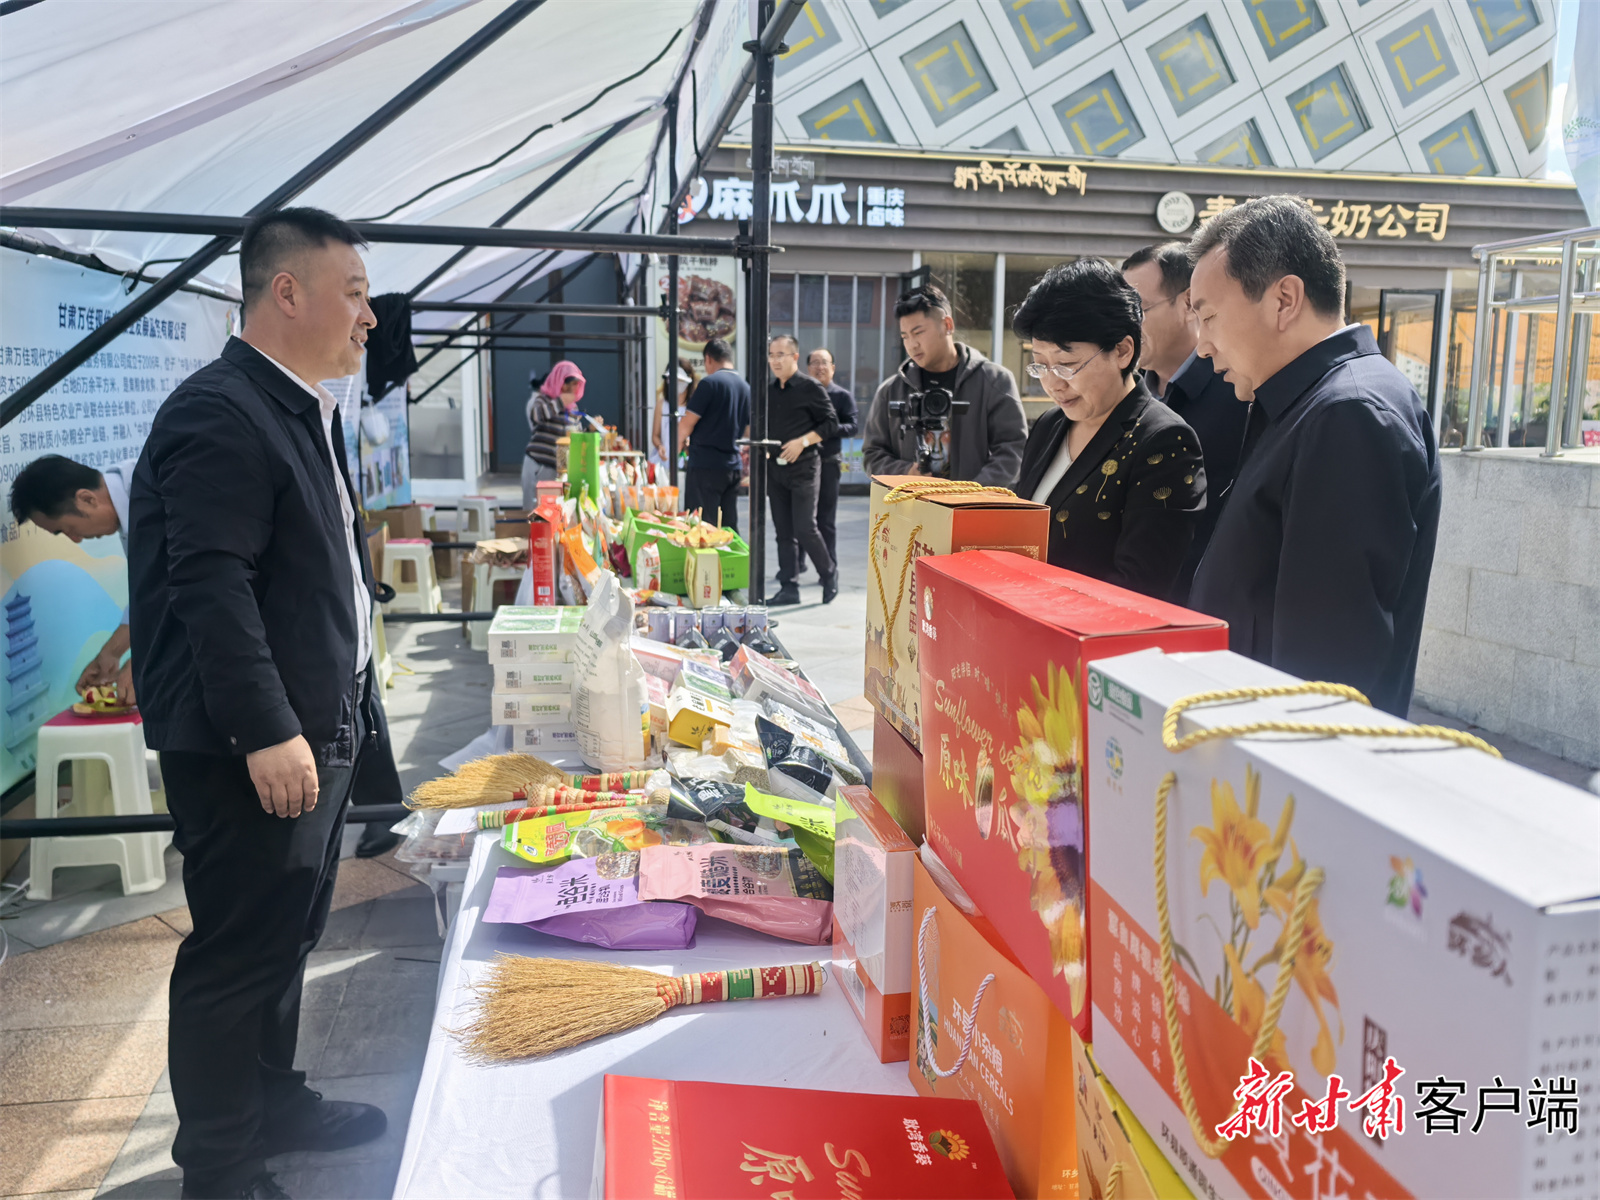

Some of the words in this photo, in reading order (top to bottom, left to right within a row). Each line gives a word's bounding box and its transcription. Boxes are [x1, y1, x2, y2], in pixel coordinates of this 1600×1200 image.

[867, 186, 905, 207] 重庆
[934, 679, 994, 755] Sunflower
[943, 1014, 979, 1072] HUANAN
[980, 1062, 1014, 1116] CEREALS
